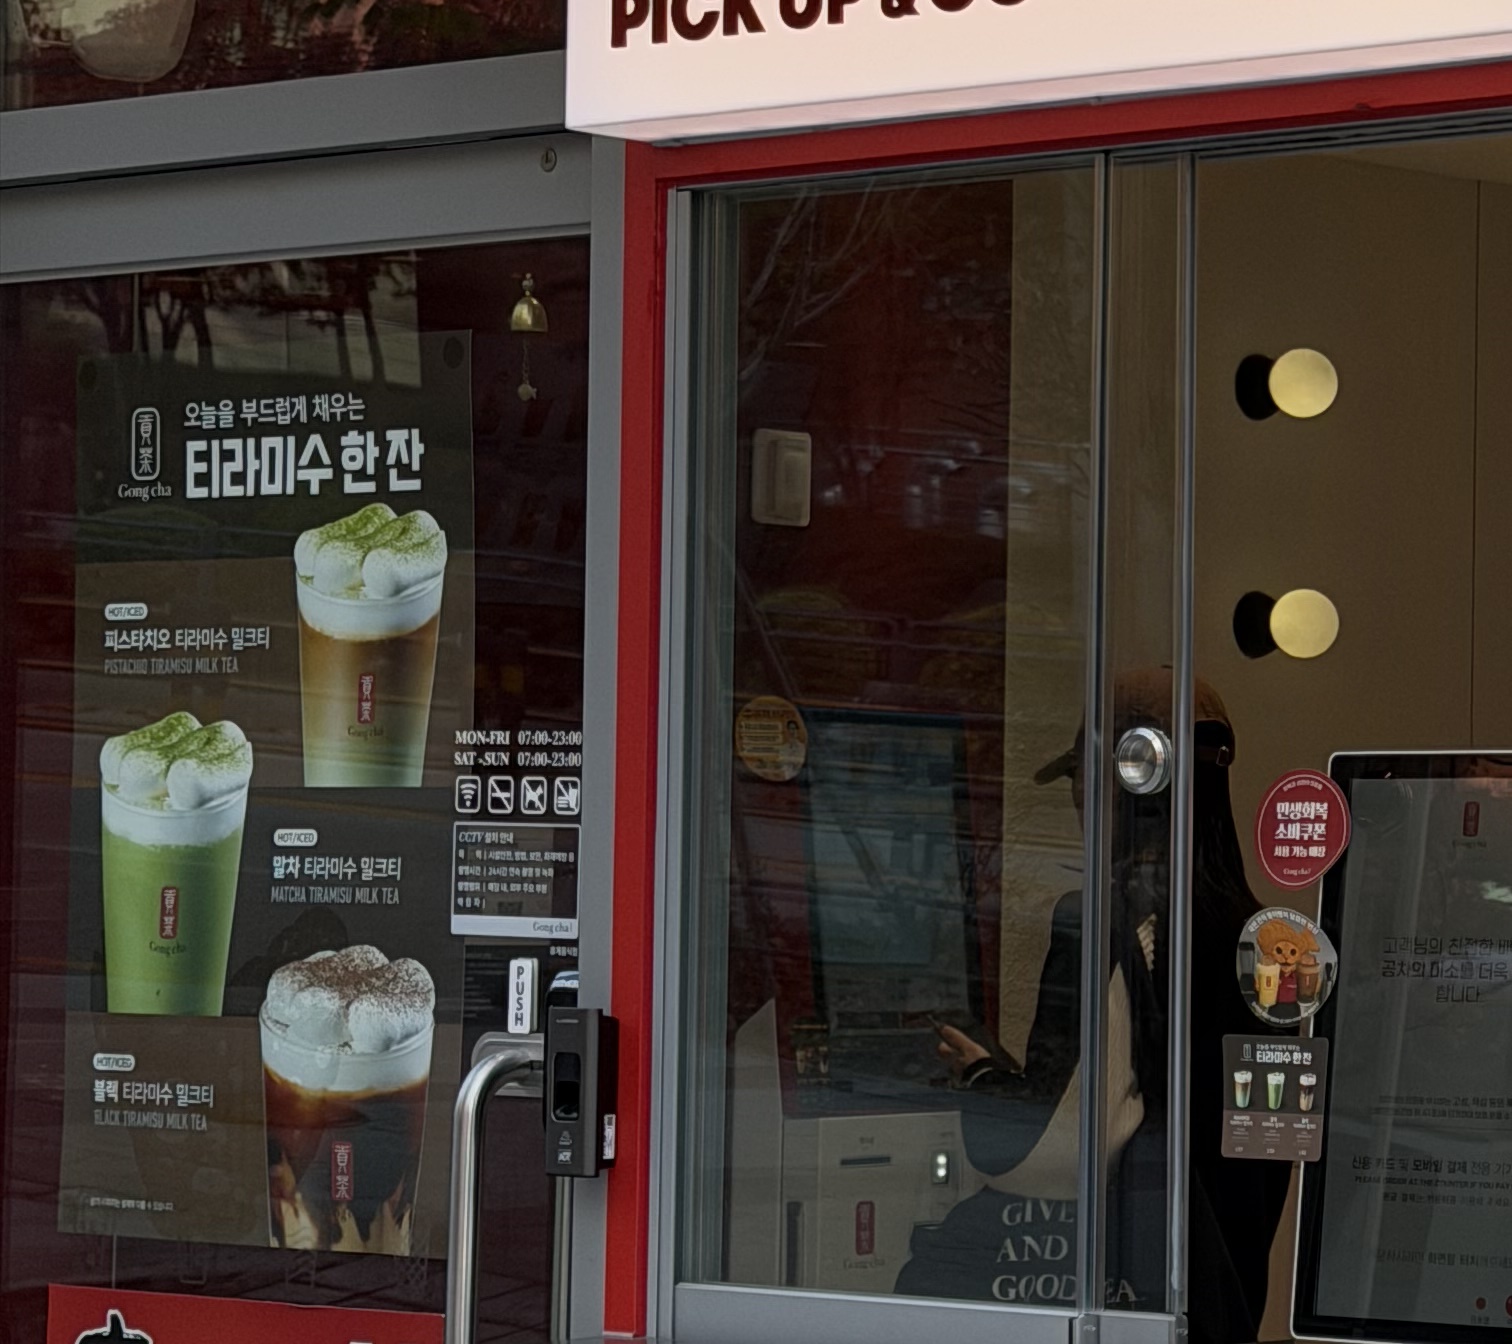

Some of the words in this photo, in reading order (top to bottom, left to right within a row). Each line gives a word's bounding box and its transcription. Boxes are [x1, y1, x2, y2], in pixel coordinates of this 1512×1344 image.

[184, 401, 235, 429] 오늘을
[240, 395, 307, 427] 부드럽게
[312, 392, 365, 423] 채우는
[185, 434, 333, 499] 티라미수
[340, 430, 379, 494] 한
[385, 428, 425, 492] 잔
[118, 483, 150, 501] Gong
[151, 481, 172, 498] cha
[104, 628, 171, 652] 피스타치오
[175, 627, 229, 651] 티라미수
[231, 626, 270, 651] 밀크티
[104, 658, 147, 675] PISTACHIO
[150, 657, 193, 674] TIRAMISU
[195, 657, 219, 674] MILK
[221, 656, 239, 673] TEA
[455, 730, 511, 745] MON-FRI
[518, 730, 582, 746] 07:00-23:00
[517, 751, 582, 767] 07:00-23:00
[1276, 801, 1328, 820] 민생회복
[459, 831, 485, 843] CCTV
[500, 832, 514, 844] 안내
[1274, 822, 1326, 841] 소비쿠폰
[1291, 846, 1307, 857] 가능
[272, 855, 301, 879] 말차
[304, 856, 358, 880] 티라미수
[361, 856, 401, 881] 밀크티
[271, 885, 307, 903] MATCHA
[309, 886, 353, 904] TIRAMISU
[354, 887, 379, 904] MILK
[382, 887, 400, 904] TEA
[533, 921, 554, 934] Gong
[1383, 937, 1443, 955] 고객님의
[1382, 959, 1426, 978] 공차의
[1430, 960, 1474, 979] 미소를
[1478, 961, 1508, 980] 더욱
[514, 965, 525, 1027] PUSH
[1256, 1051, 1291, 1063] 티라미수
[93, 1079, 119, 1103] 블랙
[122, 1081, 173, 1107] 티라미수
[176, 1083, 214, 1108] 밀크티
[94, 1109, 120, 1126] BLACK
[123, 1110, 163, 1129] TIRAMISU
[166, 1112, 188, 1130] MILK
[191, 1113, 208, 1131] TEA
[1352, 1154, 1371, 1170] 신용
[1412, 1159, 1443, 1173] 모바일
[1447, 1159, 1467, 1174] 결제
[996, 1234, 1069, 1263] AND
